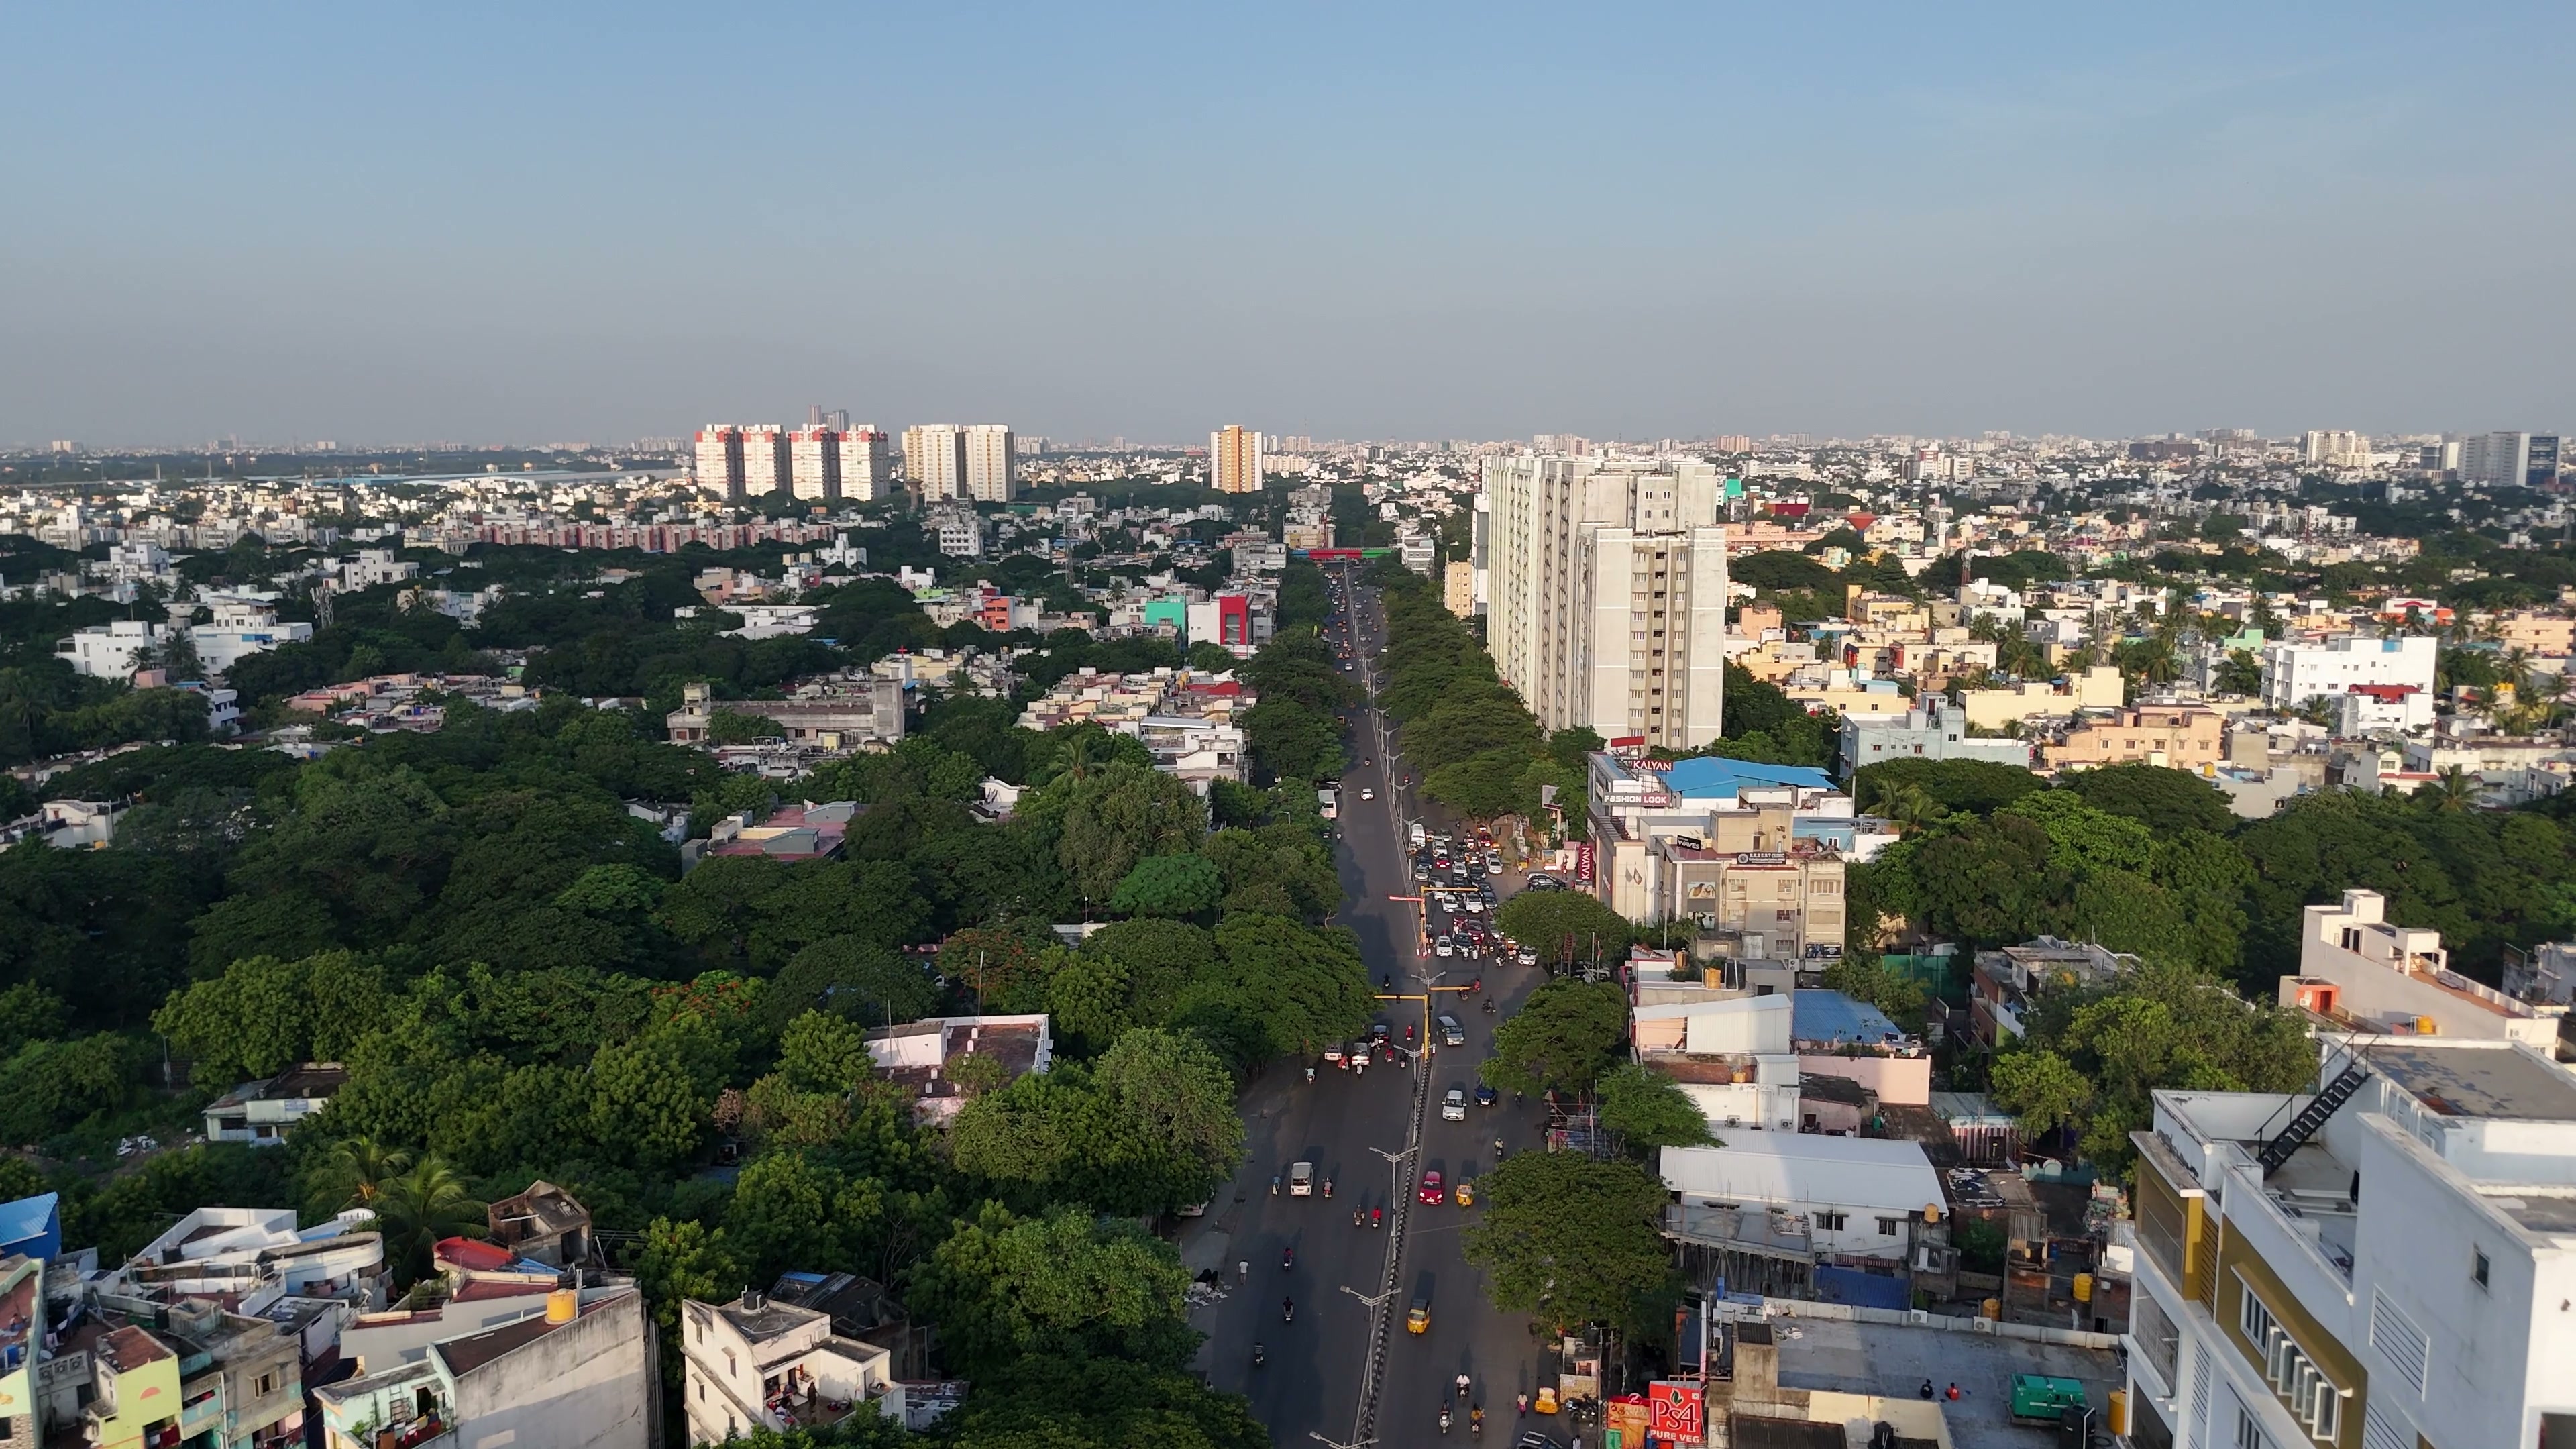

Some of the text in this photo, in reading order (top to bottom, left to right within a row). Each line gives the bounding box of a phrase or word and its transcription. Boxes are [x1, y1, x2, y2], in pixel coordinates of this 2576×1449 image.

[1633, 760, 1672, 771] KALYAN
[1678, 840, 1699, 849] WAVES
[1582, 847, 1590, 879] KALYAN
[1650, 1430, 1700, 1443] PURE VEG
